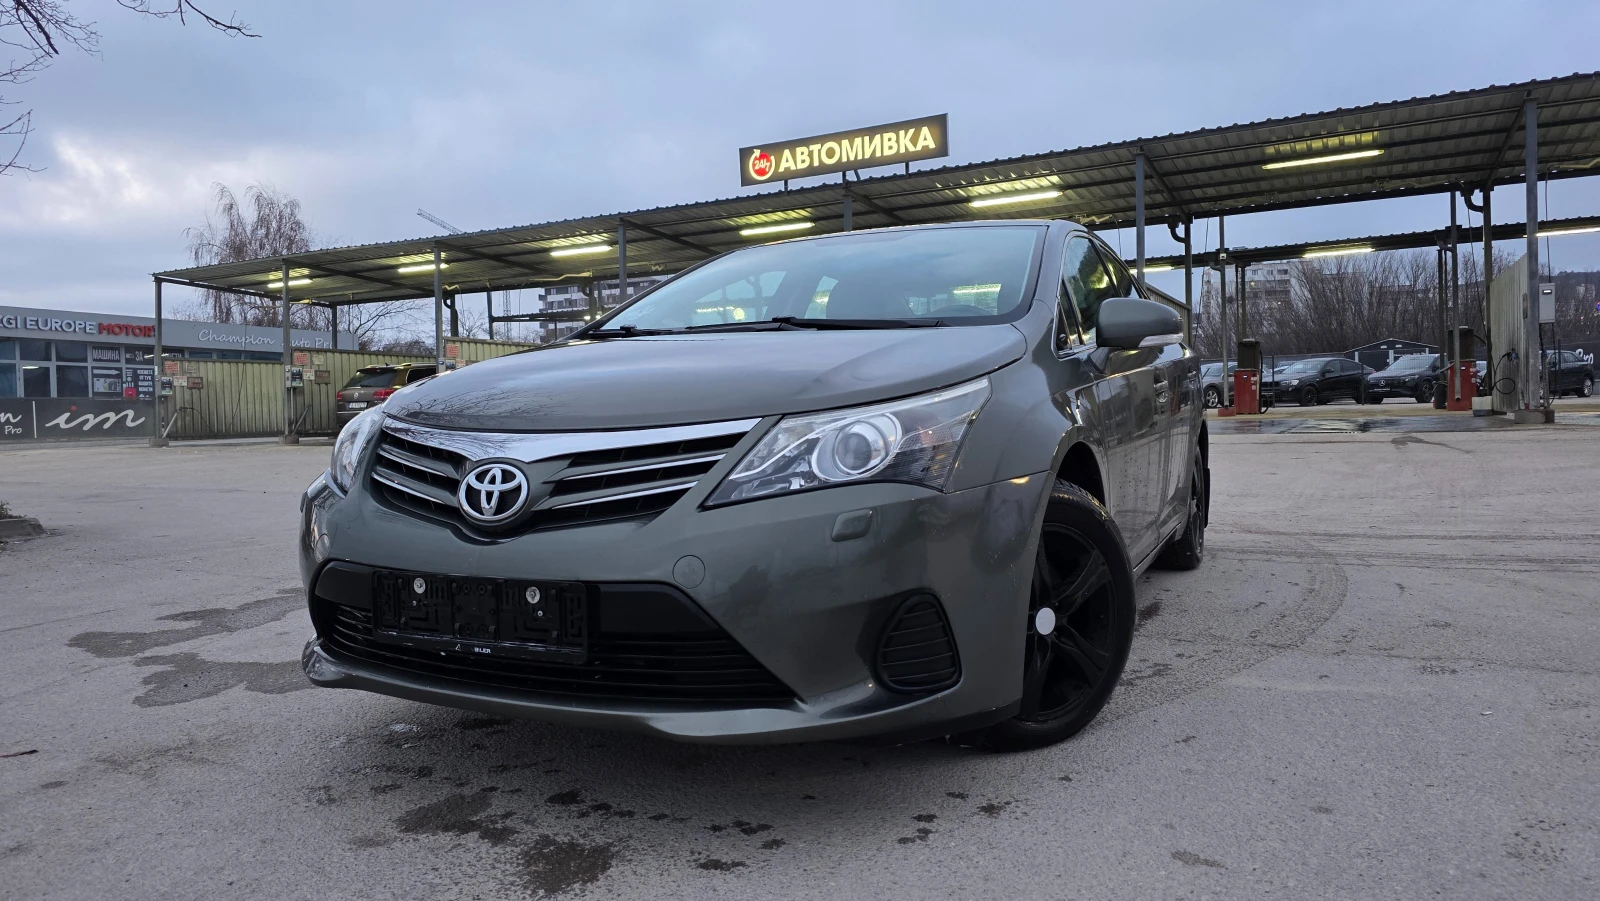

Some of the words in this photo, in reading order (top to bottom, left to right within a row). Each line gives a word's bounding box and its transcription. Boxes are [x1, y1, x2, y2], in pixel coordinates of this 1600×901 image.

[754, 158, 771, 172] 24/7
[778, 126, 936, 173] АВТОМИВКА
[26, 316, 97, 334] EUROPE
[99, 322, 156, 338] MOTOR
[198, 329, 275, 348] Champion
[281, 337, 311, 348] uto
[92, 348, 120, 361] МАШИНА
[4, 425, 22, 435] Pro
